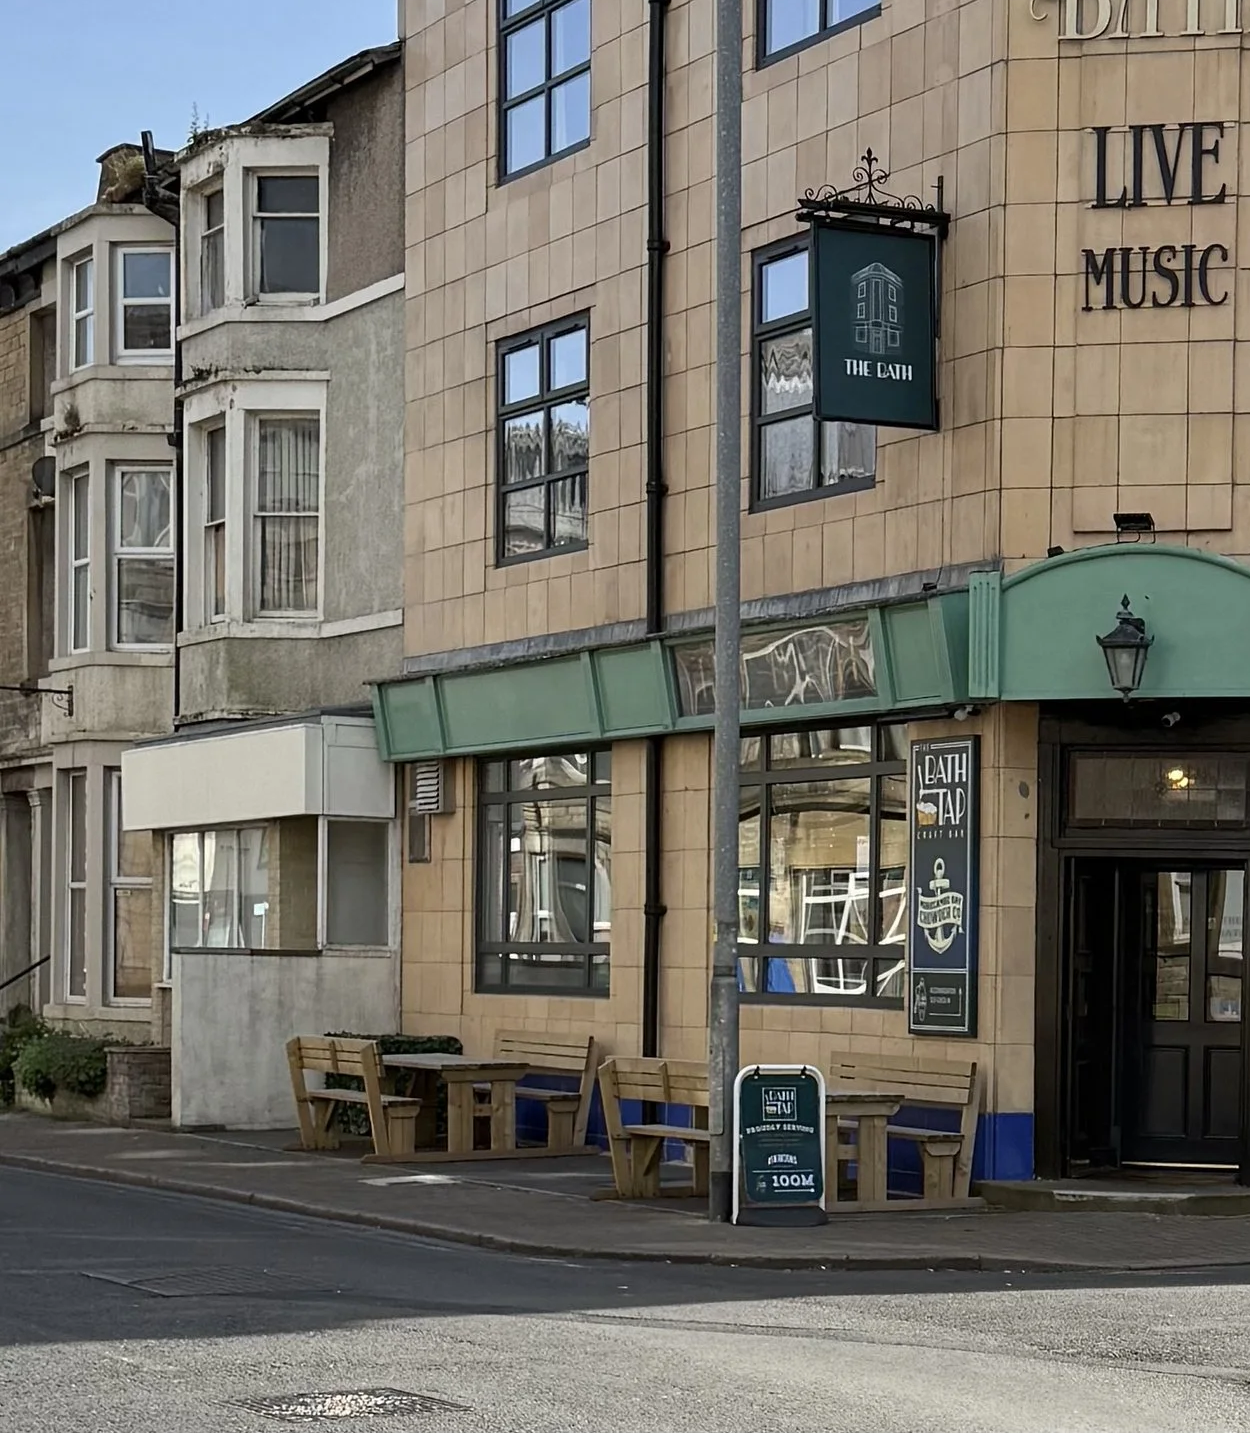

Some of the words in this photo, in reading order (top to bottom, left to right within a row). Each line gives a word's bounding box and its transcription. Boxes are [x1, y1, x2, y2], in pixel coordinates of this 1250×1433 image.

[1090, 122, 1228, 210] LIVE
[1081, 243, 1229, 312] MUSIC
[844, 358, 872, 377] THE
[877, 362, 913, 381] BATH
[925, 753, 966, 784] BATH
[935, 788, 966, 826] TAP
[776, 1101, 793, 1114] TAP
[772, 1174, 815, 1187] 100M
